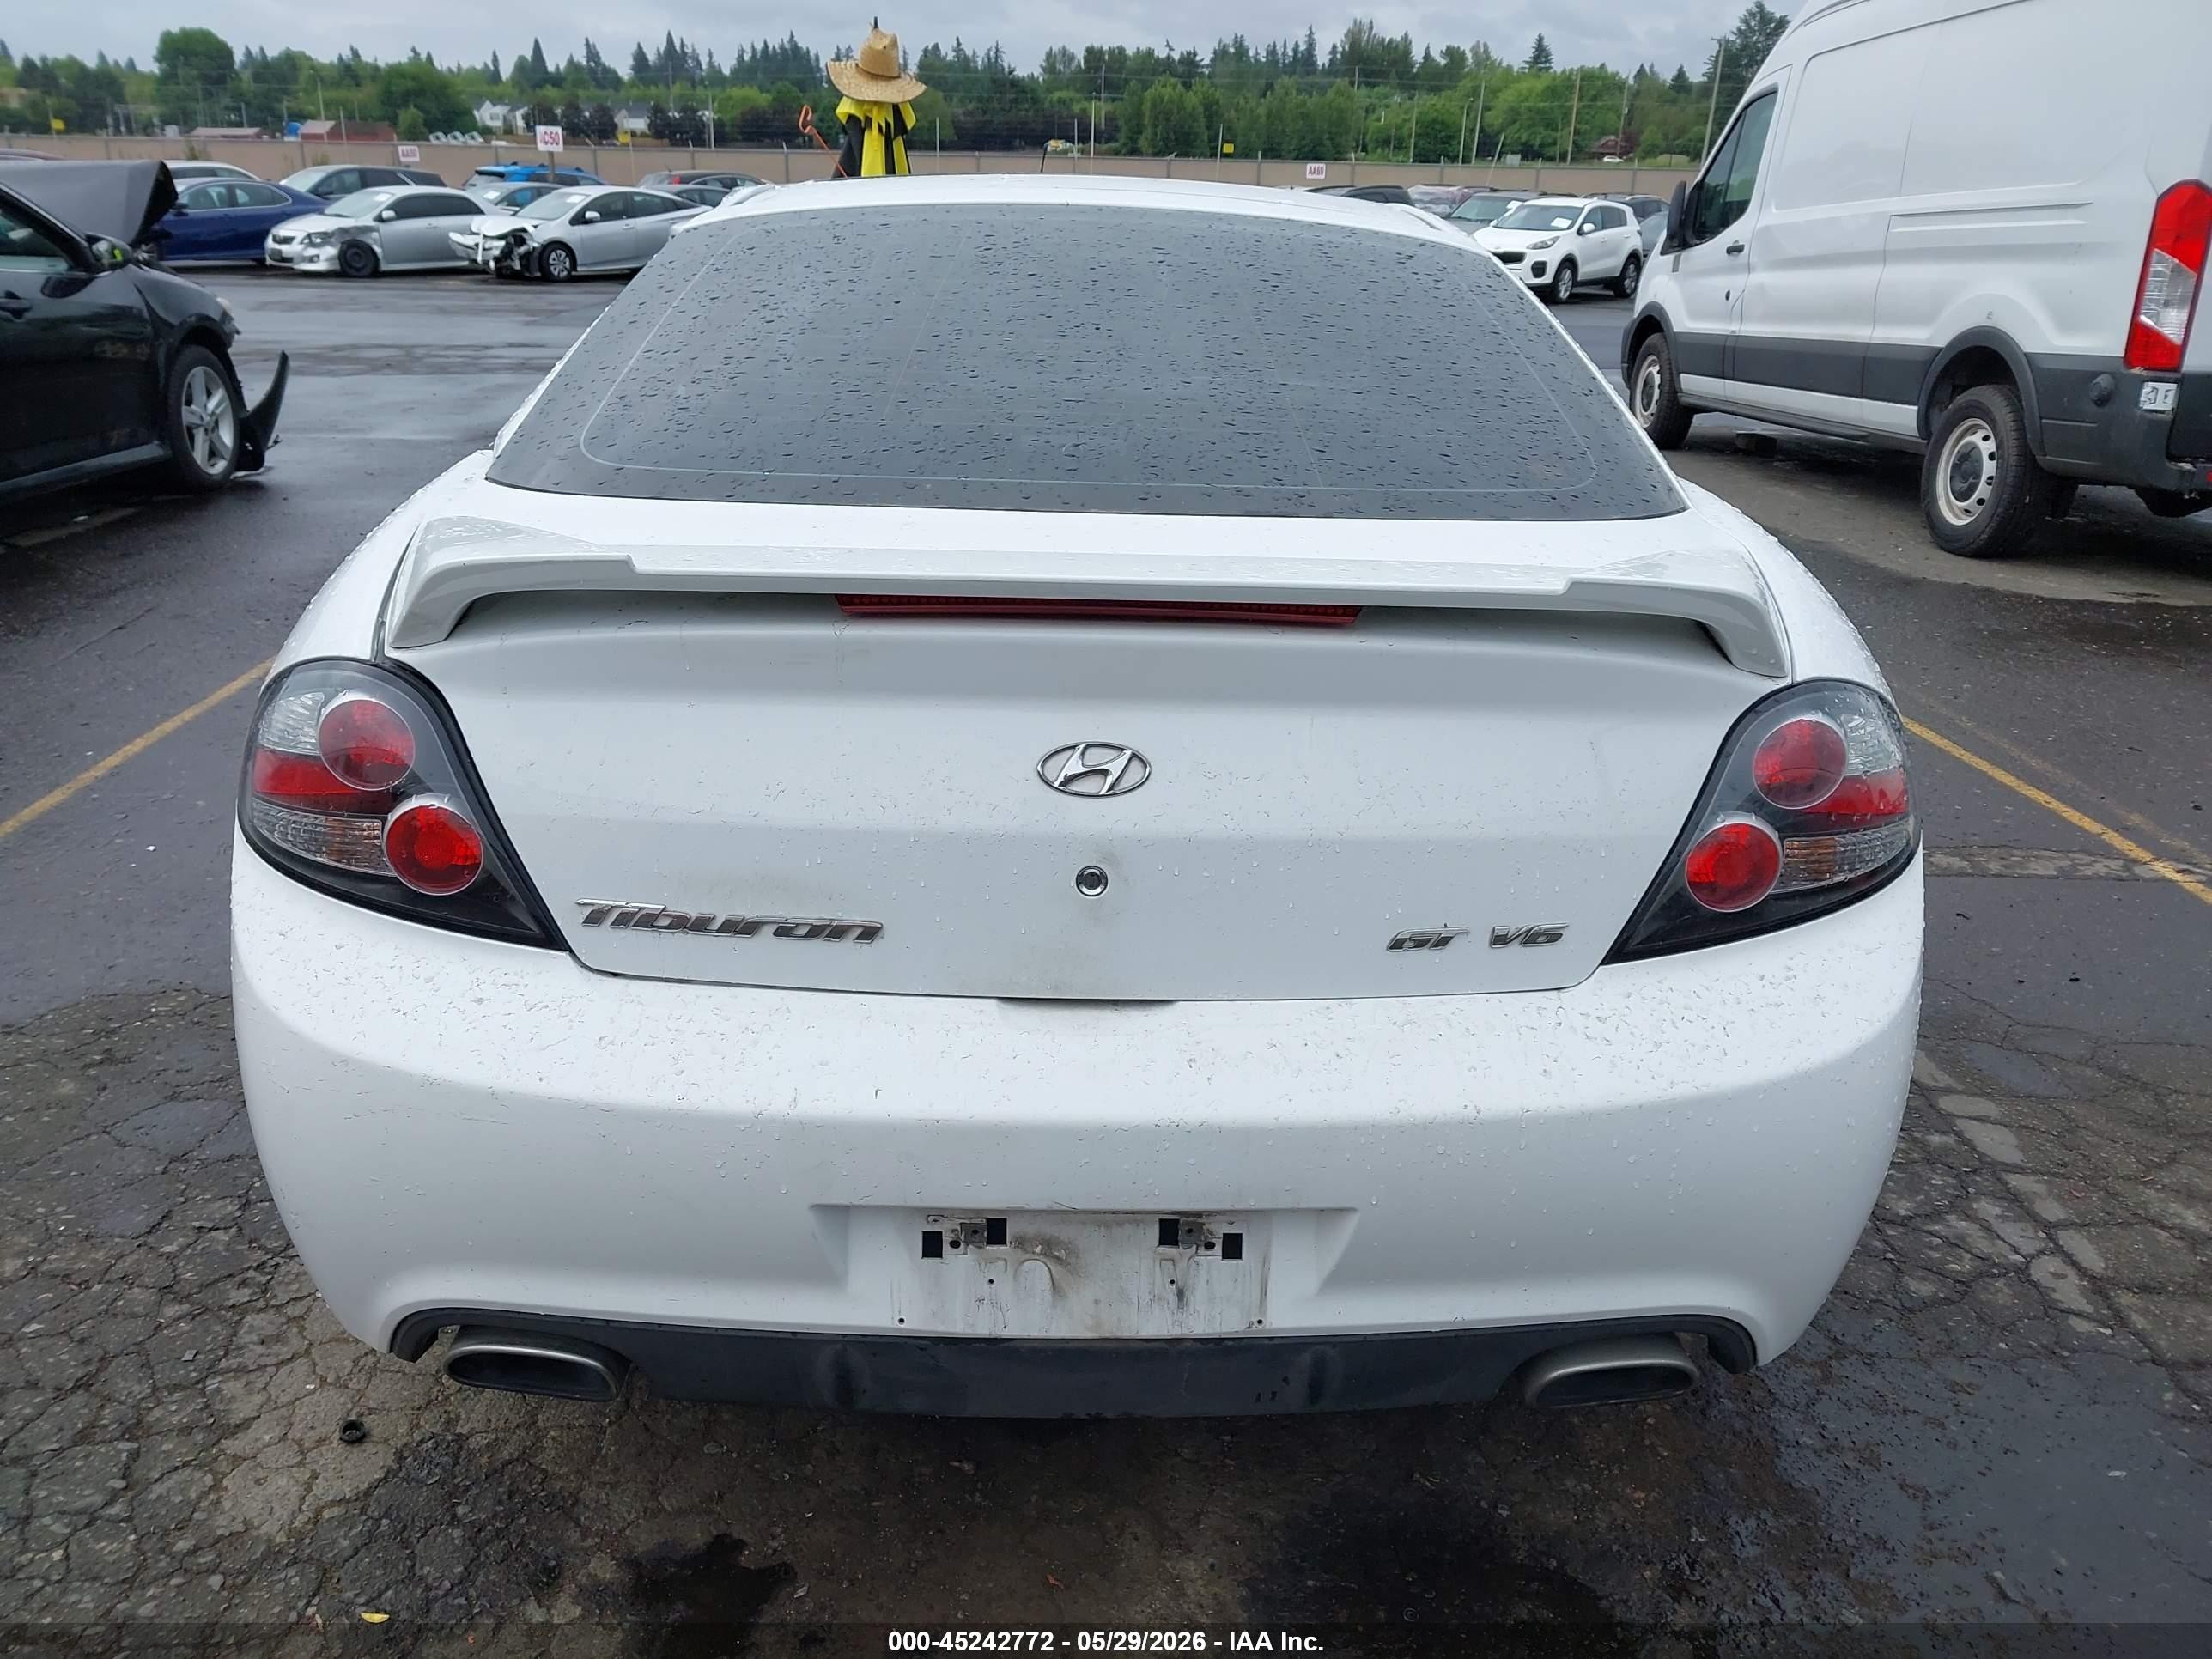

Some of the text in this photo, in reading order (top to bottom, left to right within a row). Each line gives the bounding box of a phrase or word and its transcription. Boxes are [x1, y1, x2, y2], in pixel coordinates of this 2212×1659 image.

[574, 897, 884, 944] Tiburon
[1386, 922, 1570, 952] GT V6
